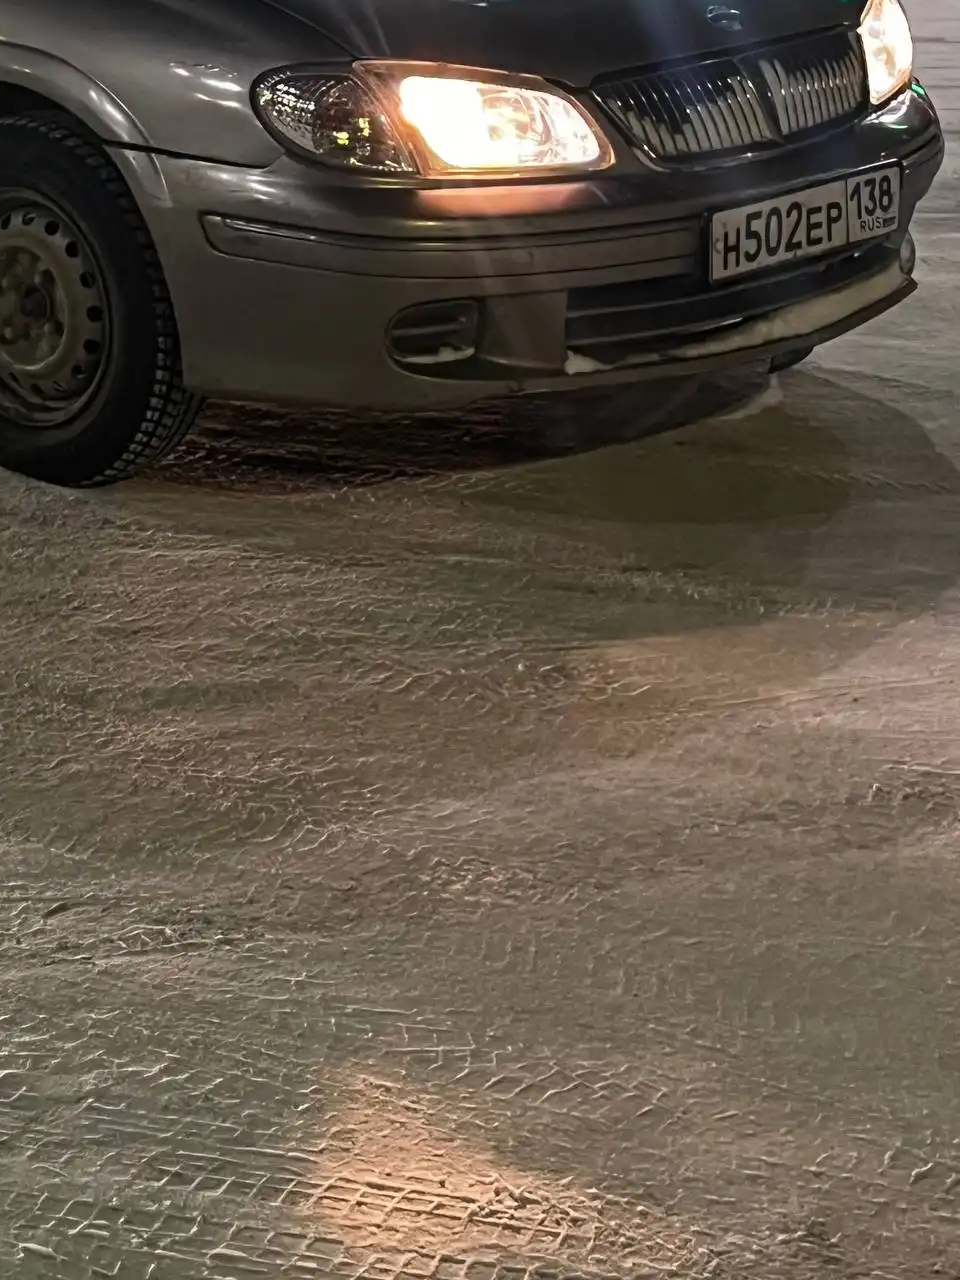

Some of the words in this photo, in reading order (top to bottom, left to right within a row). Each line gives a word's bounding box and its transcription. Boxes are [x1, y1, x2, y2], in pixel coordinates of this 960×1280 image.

[723, 201, 842, 270] Н502ЕР
[849, 174, 894, 220] 138
[859, 216, 882, 233] RUS
